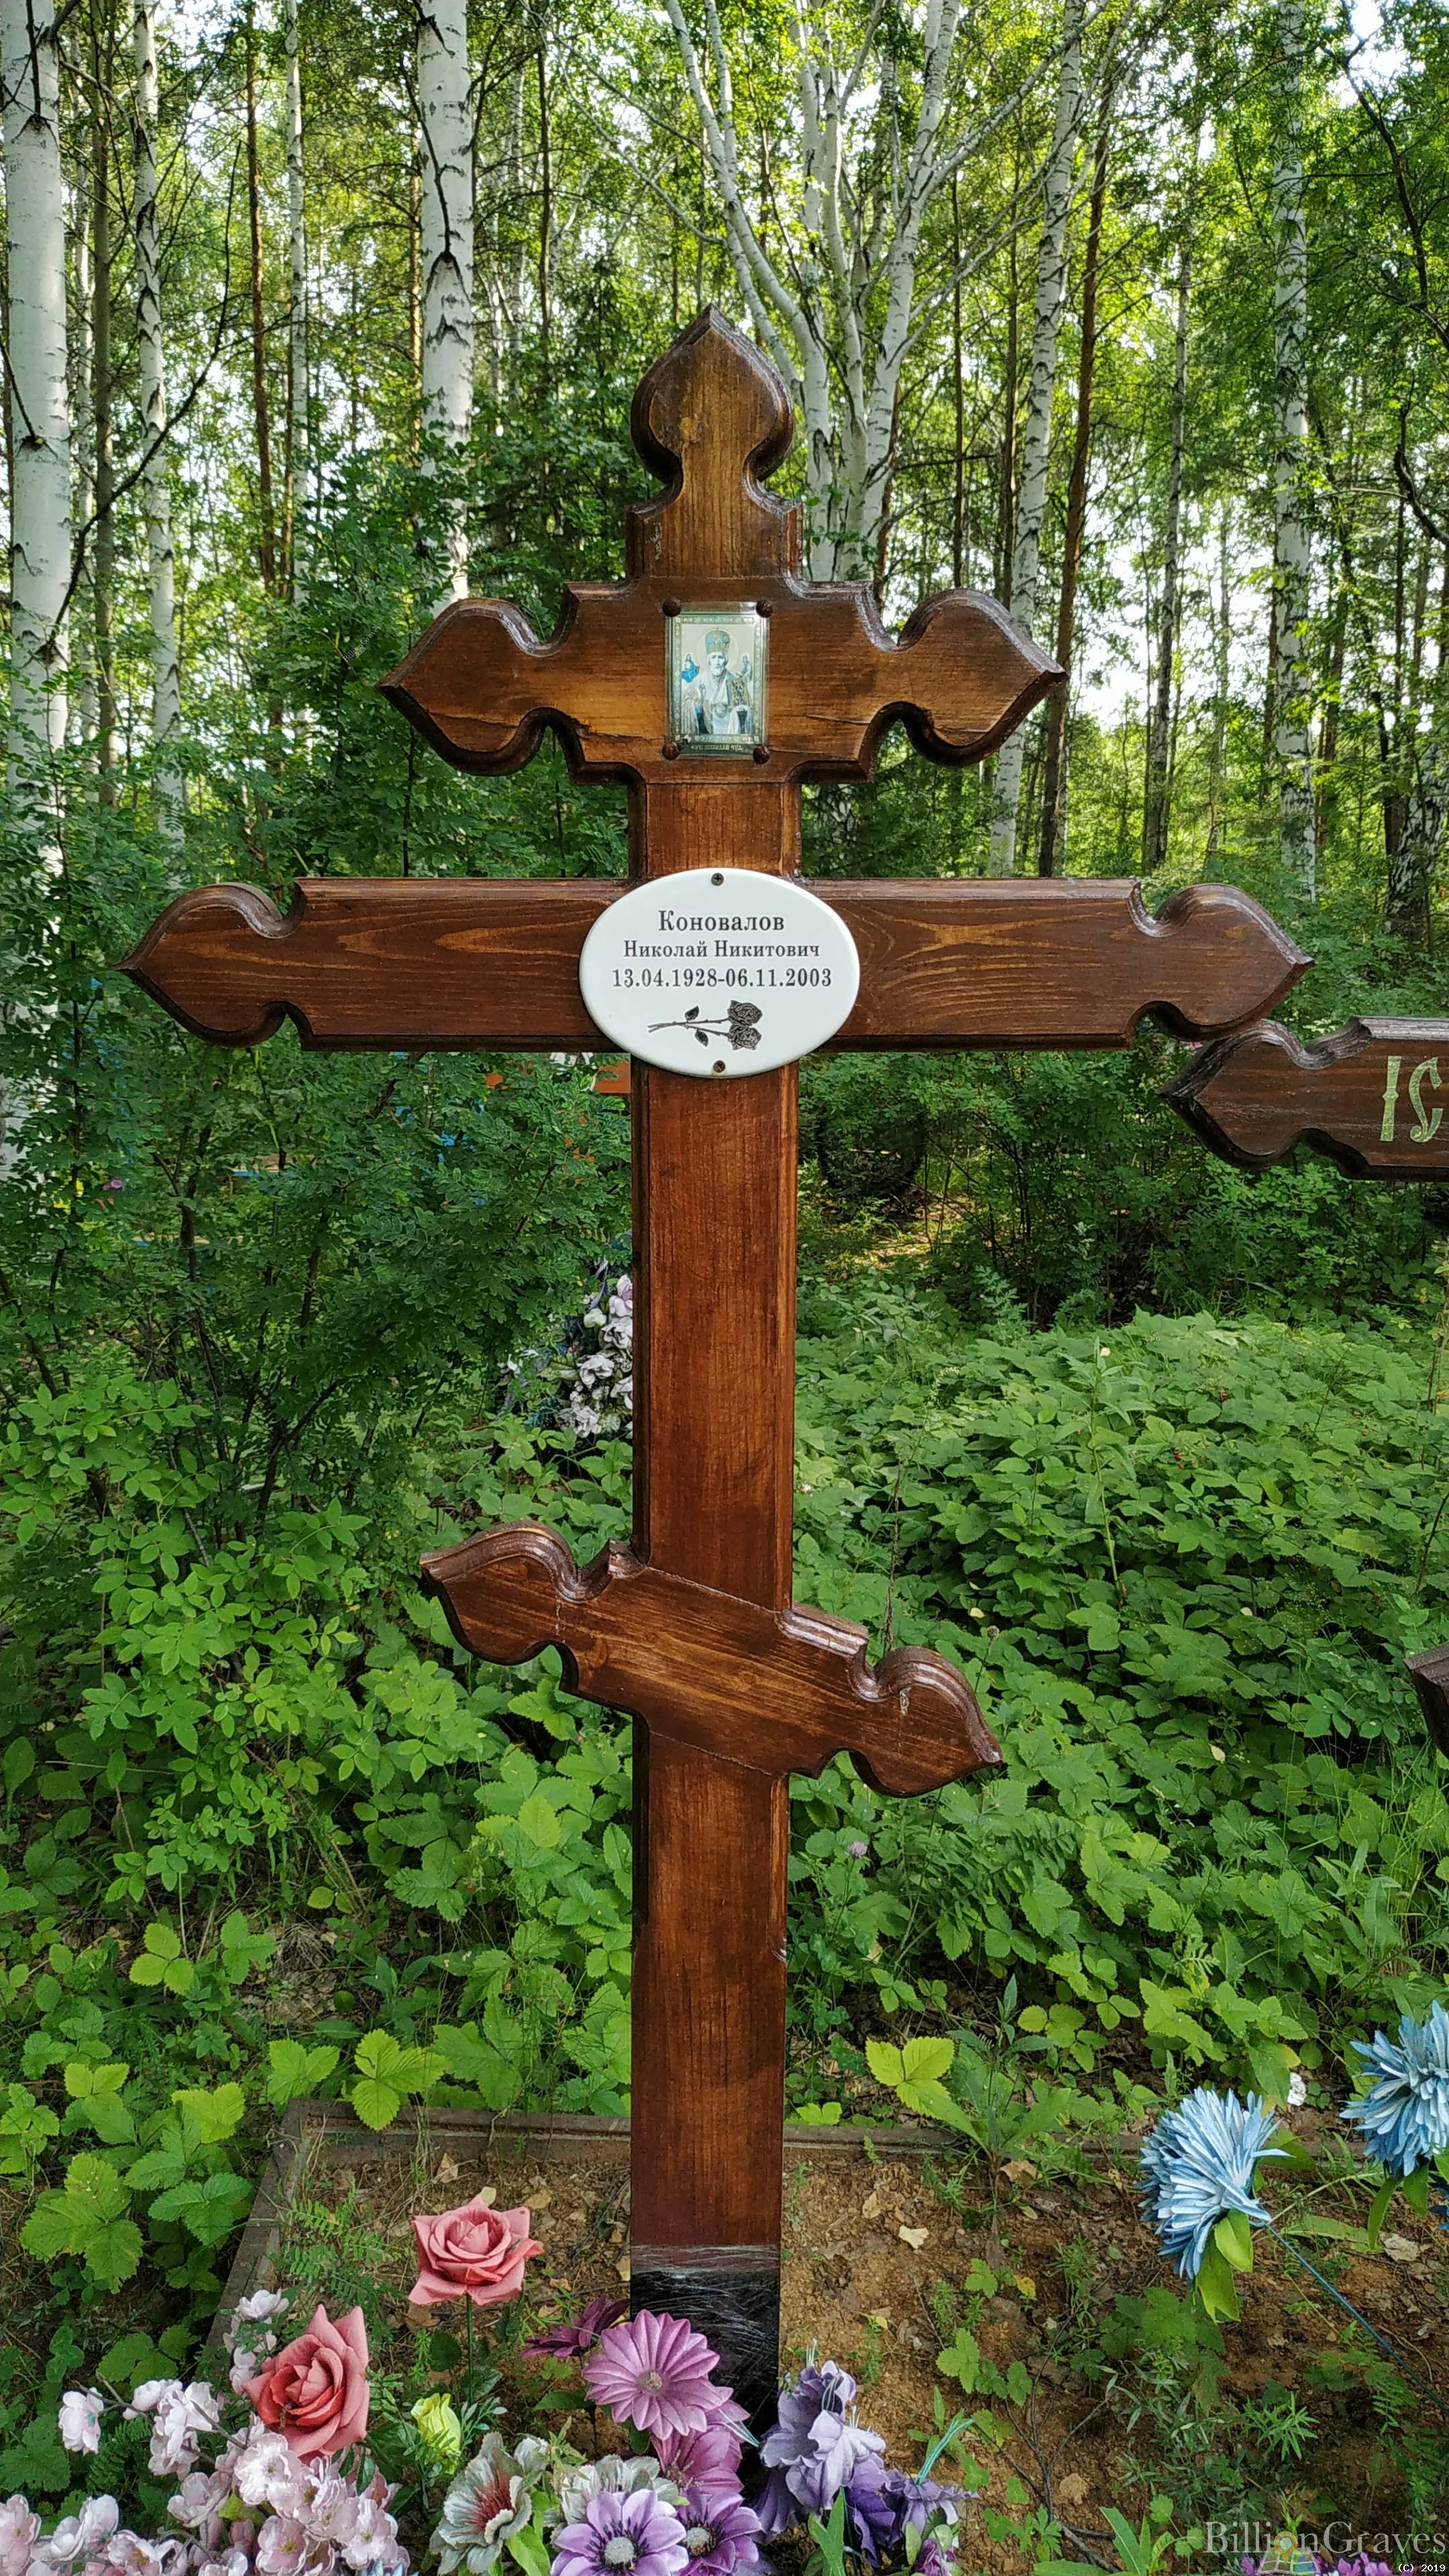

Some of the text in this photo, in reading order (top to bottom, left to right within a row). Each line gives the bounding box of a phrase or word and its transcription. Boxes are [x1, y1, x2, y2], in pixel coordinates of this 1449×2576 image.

[657, 910, 785, 931] Коновалов
[624, 940, 820, 957] Николай Никитович
[612, 968, 832, 988] 13.04.1928-06.11.2003
